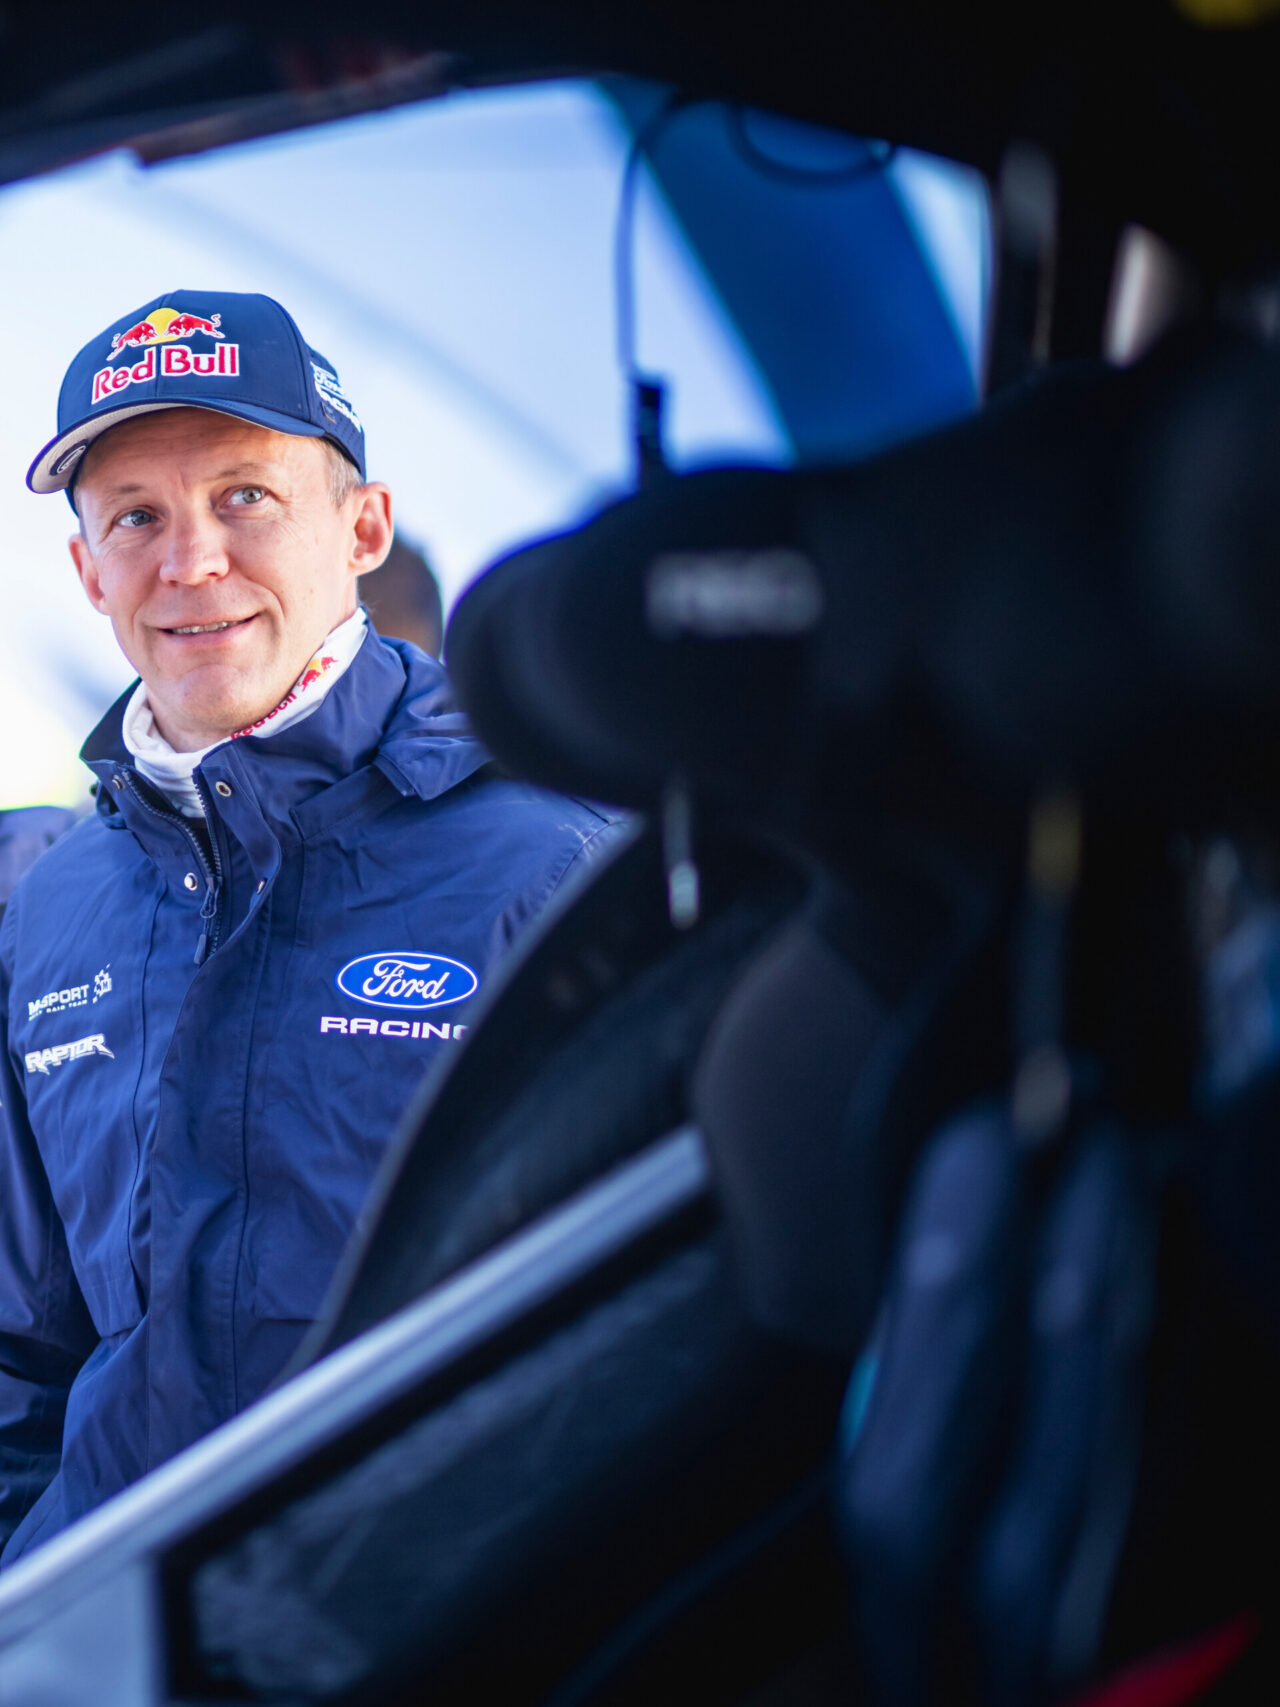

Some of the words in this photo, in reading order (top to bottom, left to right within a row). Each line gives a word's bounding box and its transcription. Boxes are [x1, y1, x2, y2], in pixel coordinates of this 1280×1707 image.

[91, 346, 156, 405] Red
[161, 343, 239, 377] Bull
[362, 959, 450, 999] Ford
[25, 1033, 115, 1075] RAPTOR
